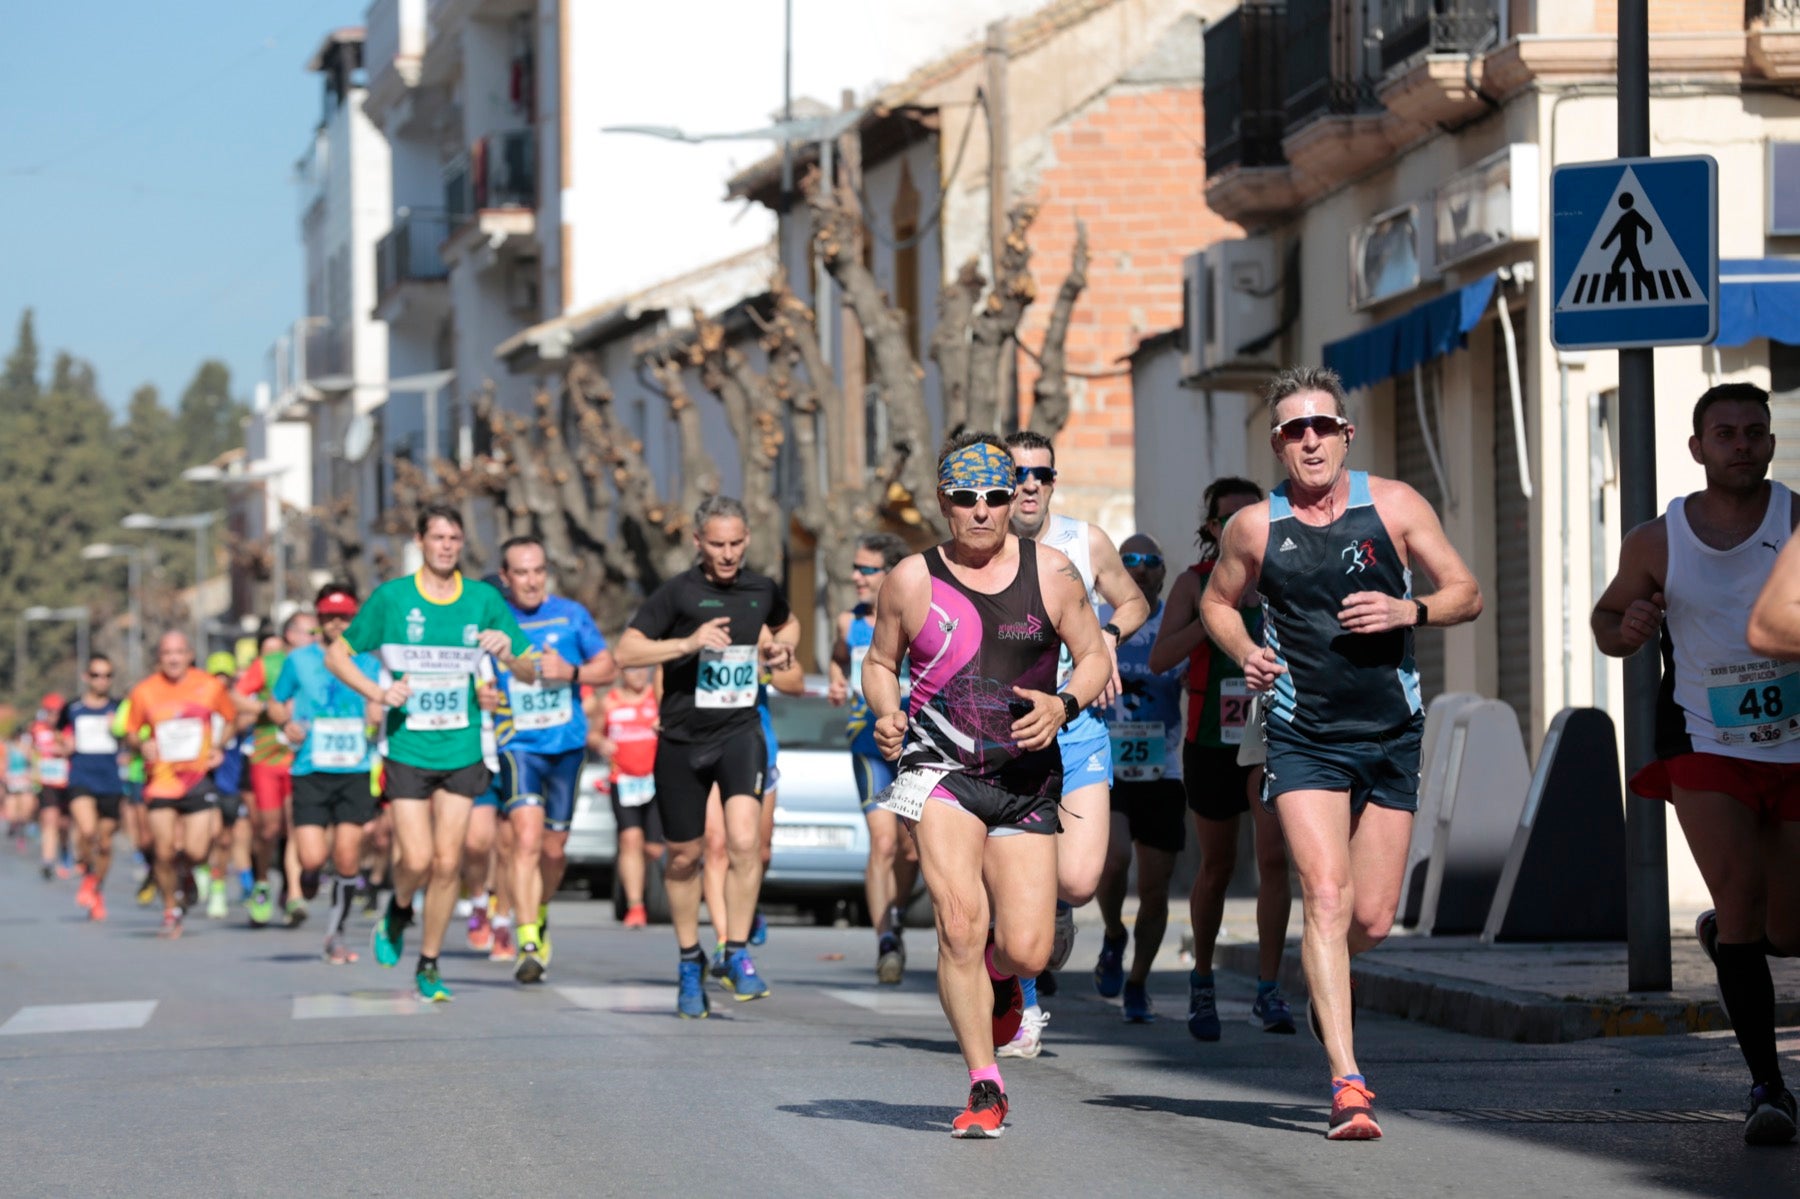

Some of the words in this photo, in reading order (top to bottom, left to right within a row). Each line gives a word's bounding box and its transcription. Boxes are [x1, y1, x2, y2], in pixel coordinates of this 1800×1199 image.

[998, 631, 1031, 640] SANTA
[1033, 632, 1043, 641] FE
[703, 665, 753, 687] 1002
[1729, 664, 1746, 674] GRAN
[1747, 661, 1771, 671] PREMIO
[420, 692, 458, 711] 695
[522, 690, 560, 711] 832
[1739, 686, 1783, 719] 48
[1120, 741, 1149, 762] 25
